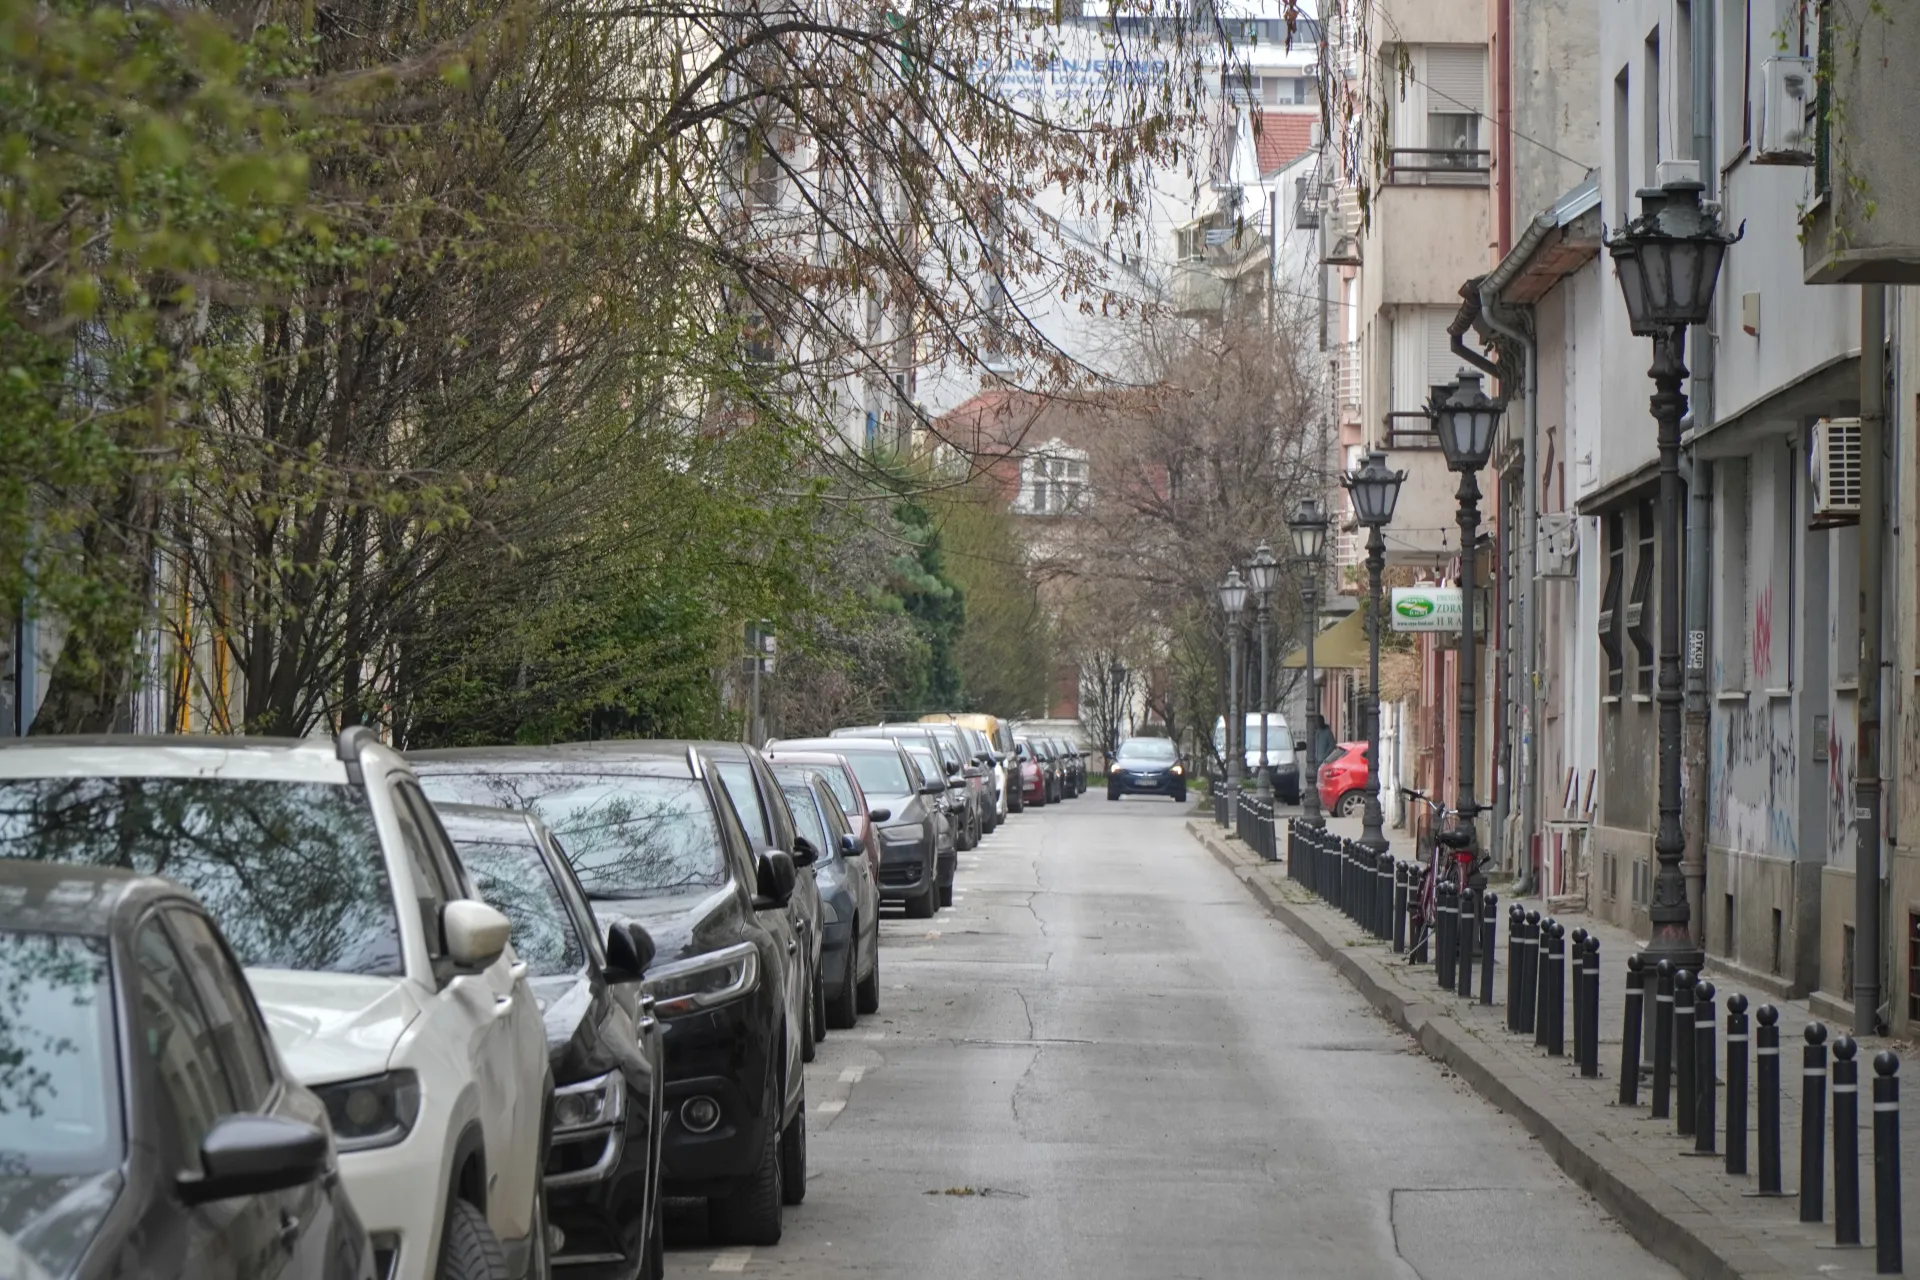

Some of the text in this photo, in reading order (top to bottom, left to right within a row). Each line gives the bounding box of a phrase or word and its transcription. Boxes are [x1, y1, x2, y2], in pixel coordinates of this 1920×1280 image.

[1008, 59, 1166, 72] INENJERING
[1437, 604, 1481, 613] ZDRAE
[1437, 616, 1481, 626] HRAE
[1695, 633, 1703, 666] OTKUP
